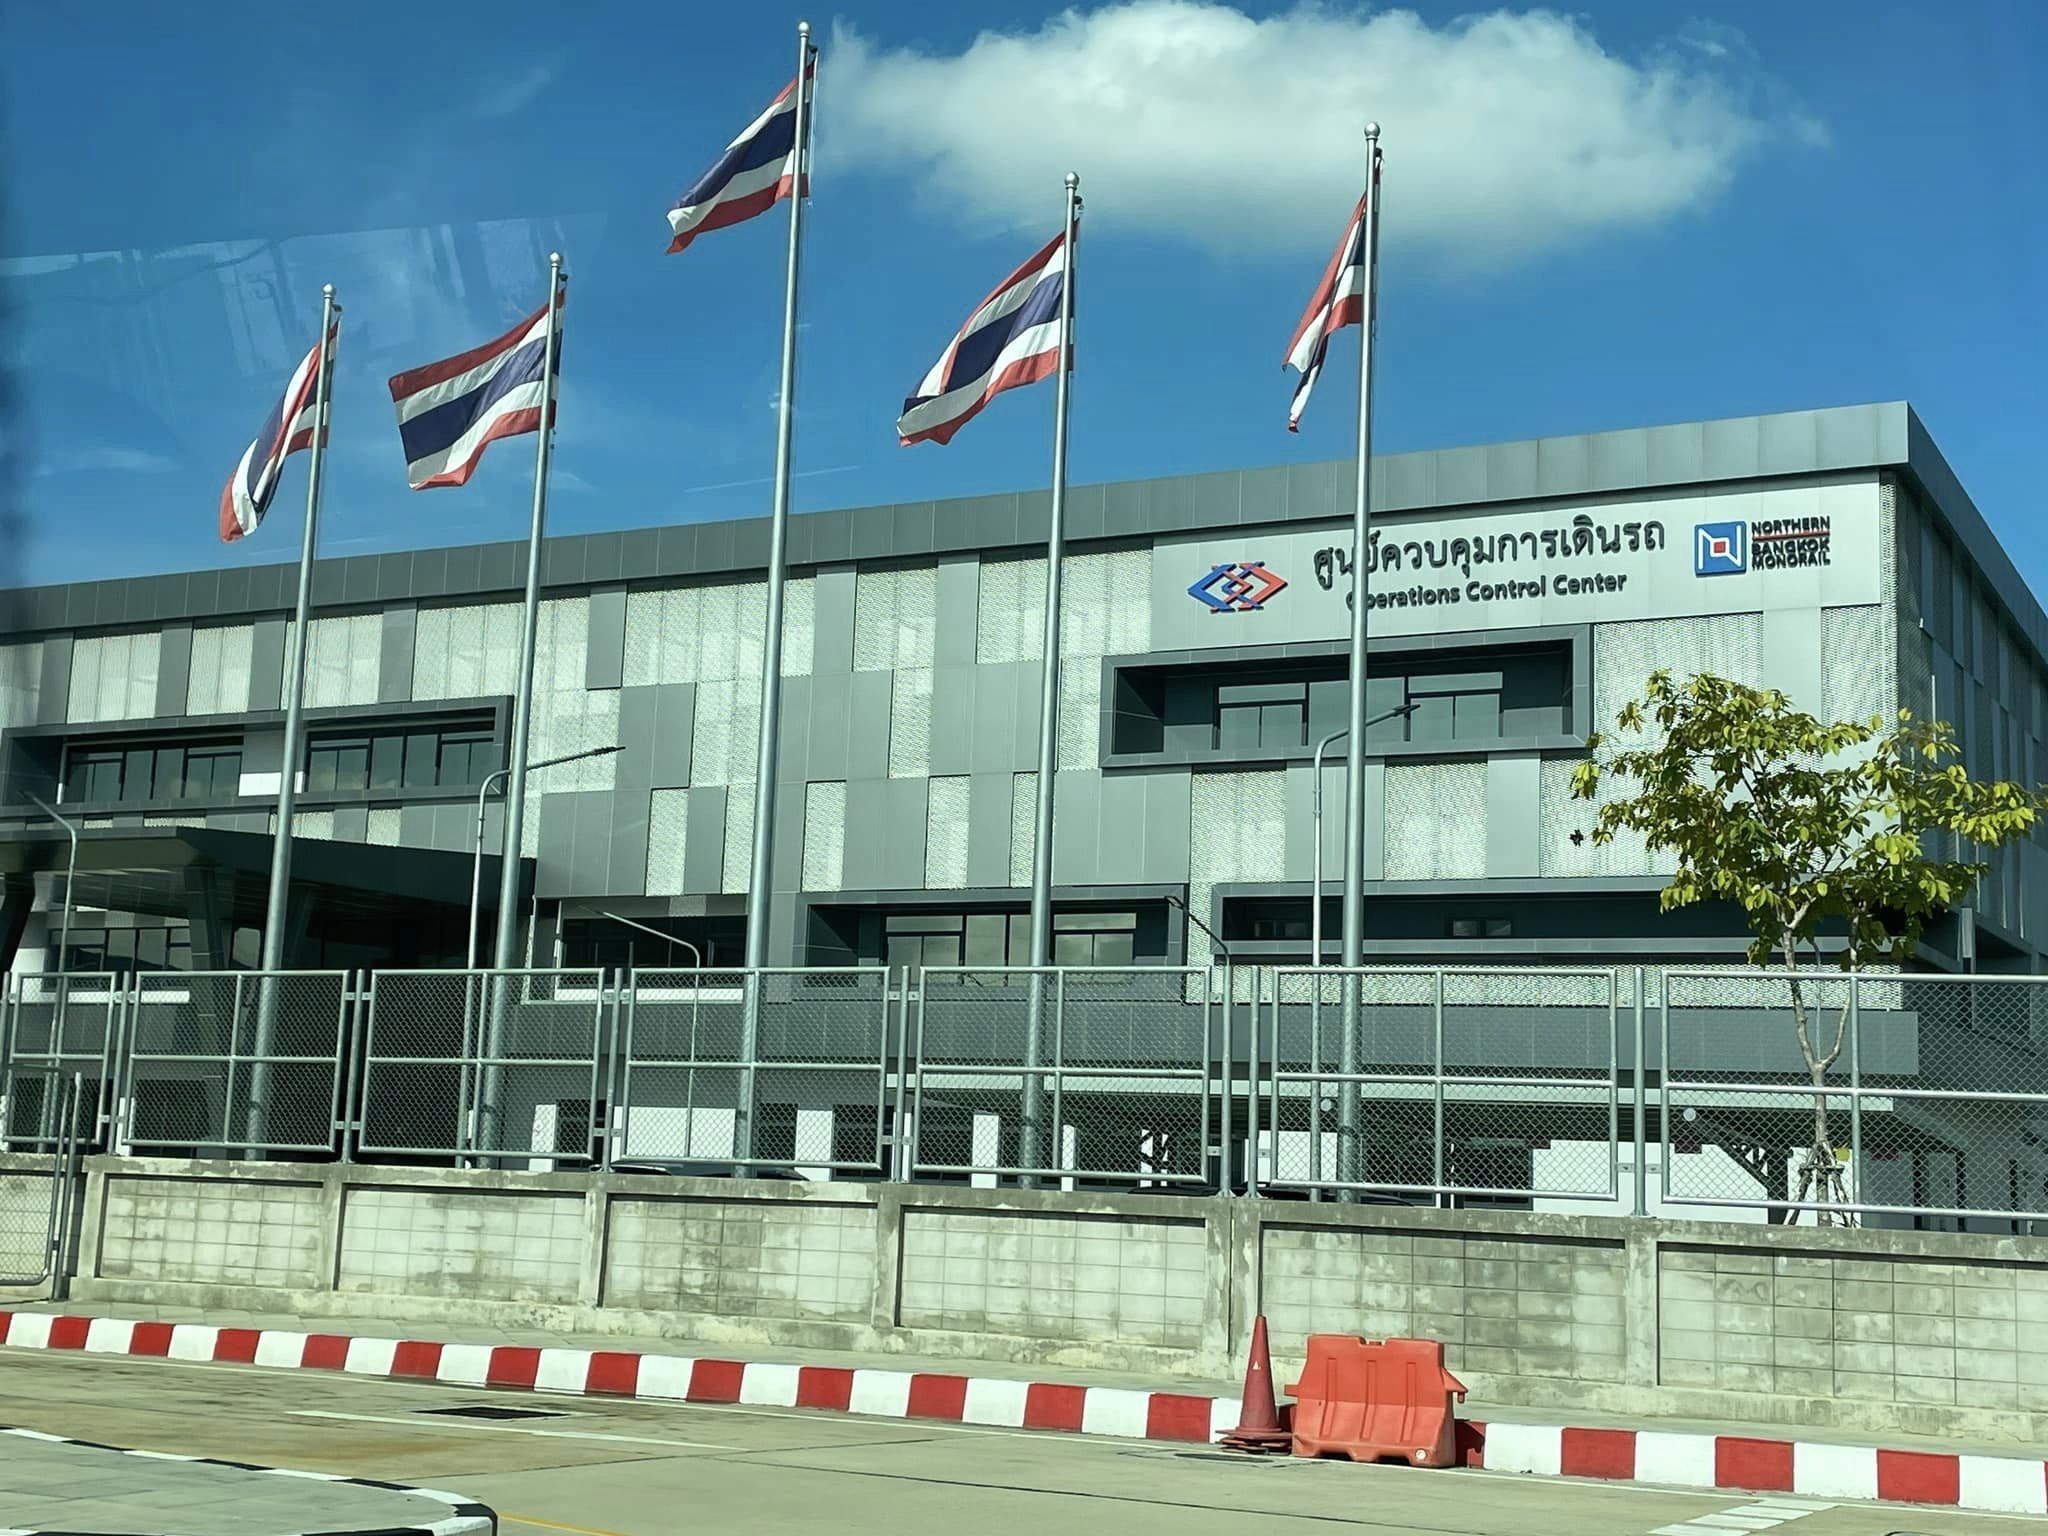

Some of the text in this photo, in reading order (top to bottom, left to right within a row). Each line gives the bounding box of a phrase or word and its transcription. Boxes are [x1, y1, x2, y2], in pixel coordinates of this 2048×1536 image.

[1751, 516, 1831, 536] NORTHERN
[1752, 537, 1831, 556] BANGKOK
[1752, 551, 1831, 571] MONORAIL
[1466, 575, 1547, 602] Control
[1553, 573, 1628, 596] Center
